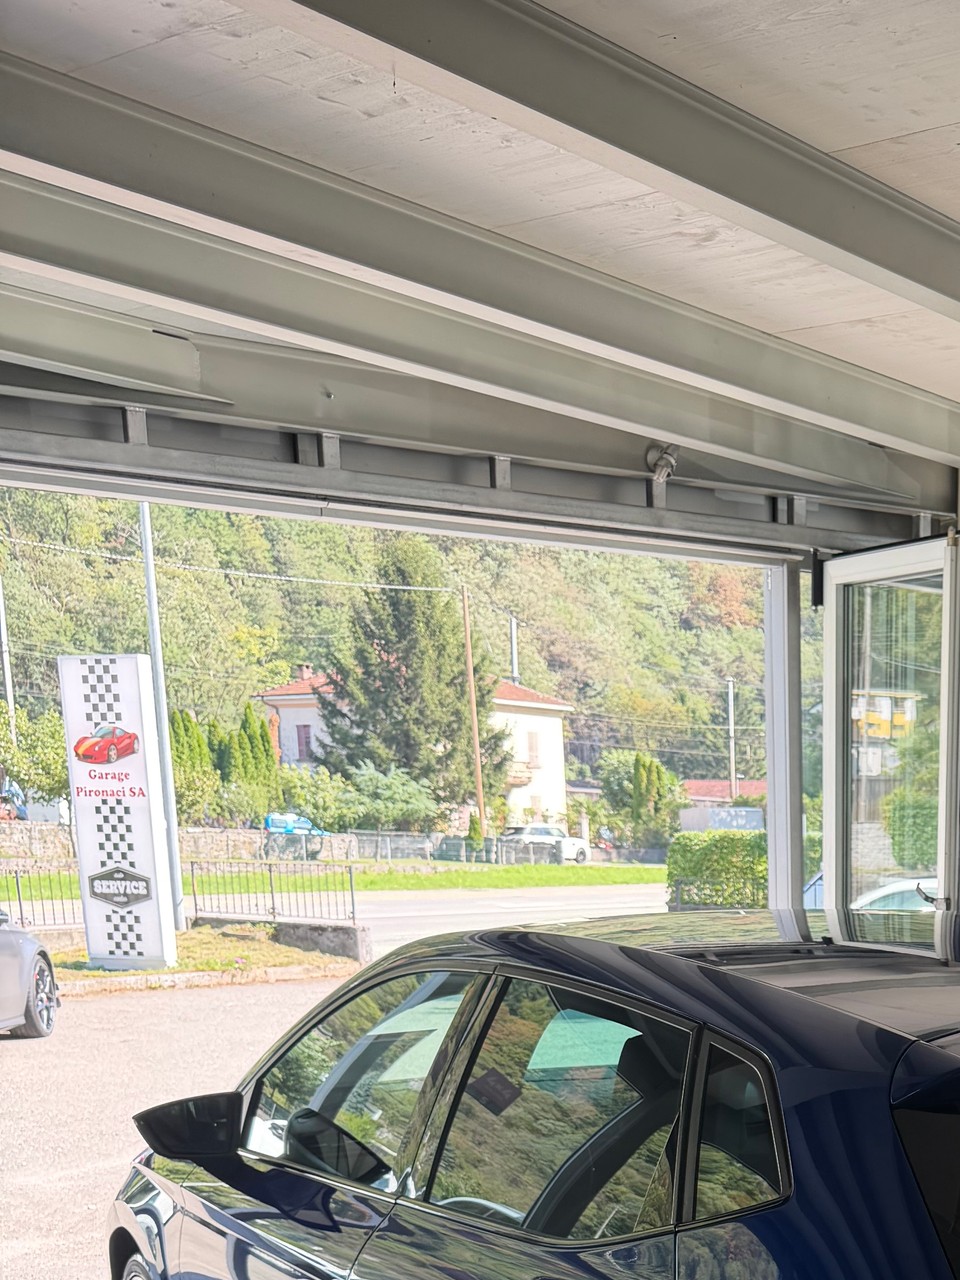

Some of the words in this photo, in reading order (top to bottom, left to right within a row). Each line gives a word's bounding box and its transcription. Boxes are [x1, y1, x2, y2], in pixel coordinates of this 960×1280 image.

[88, 769, 130, 783] Garage
[76, 786, 126, 797] Pironaci
[129, 786, 146, 798] SA
[93, 879, 148, 895] SERVICE
